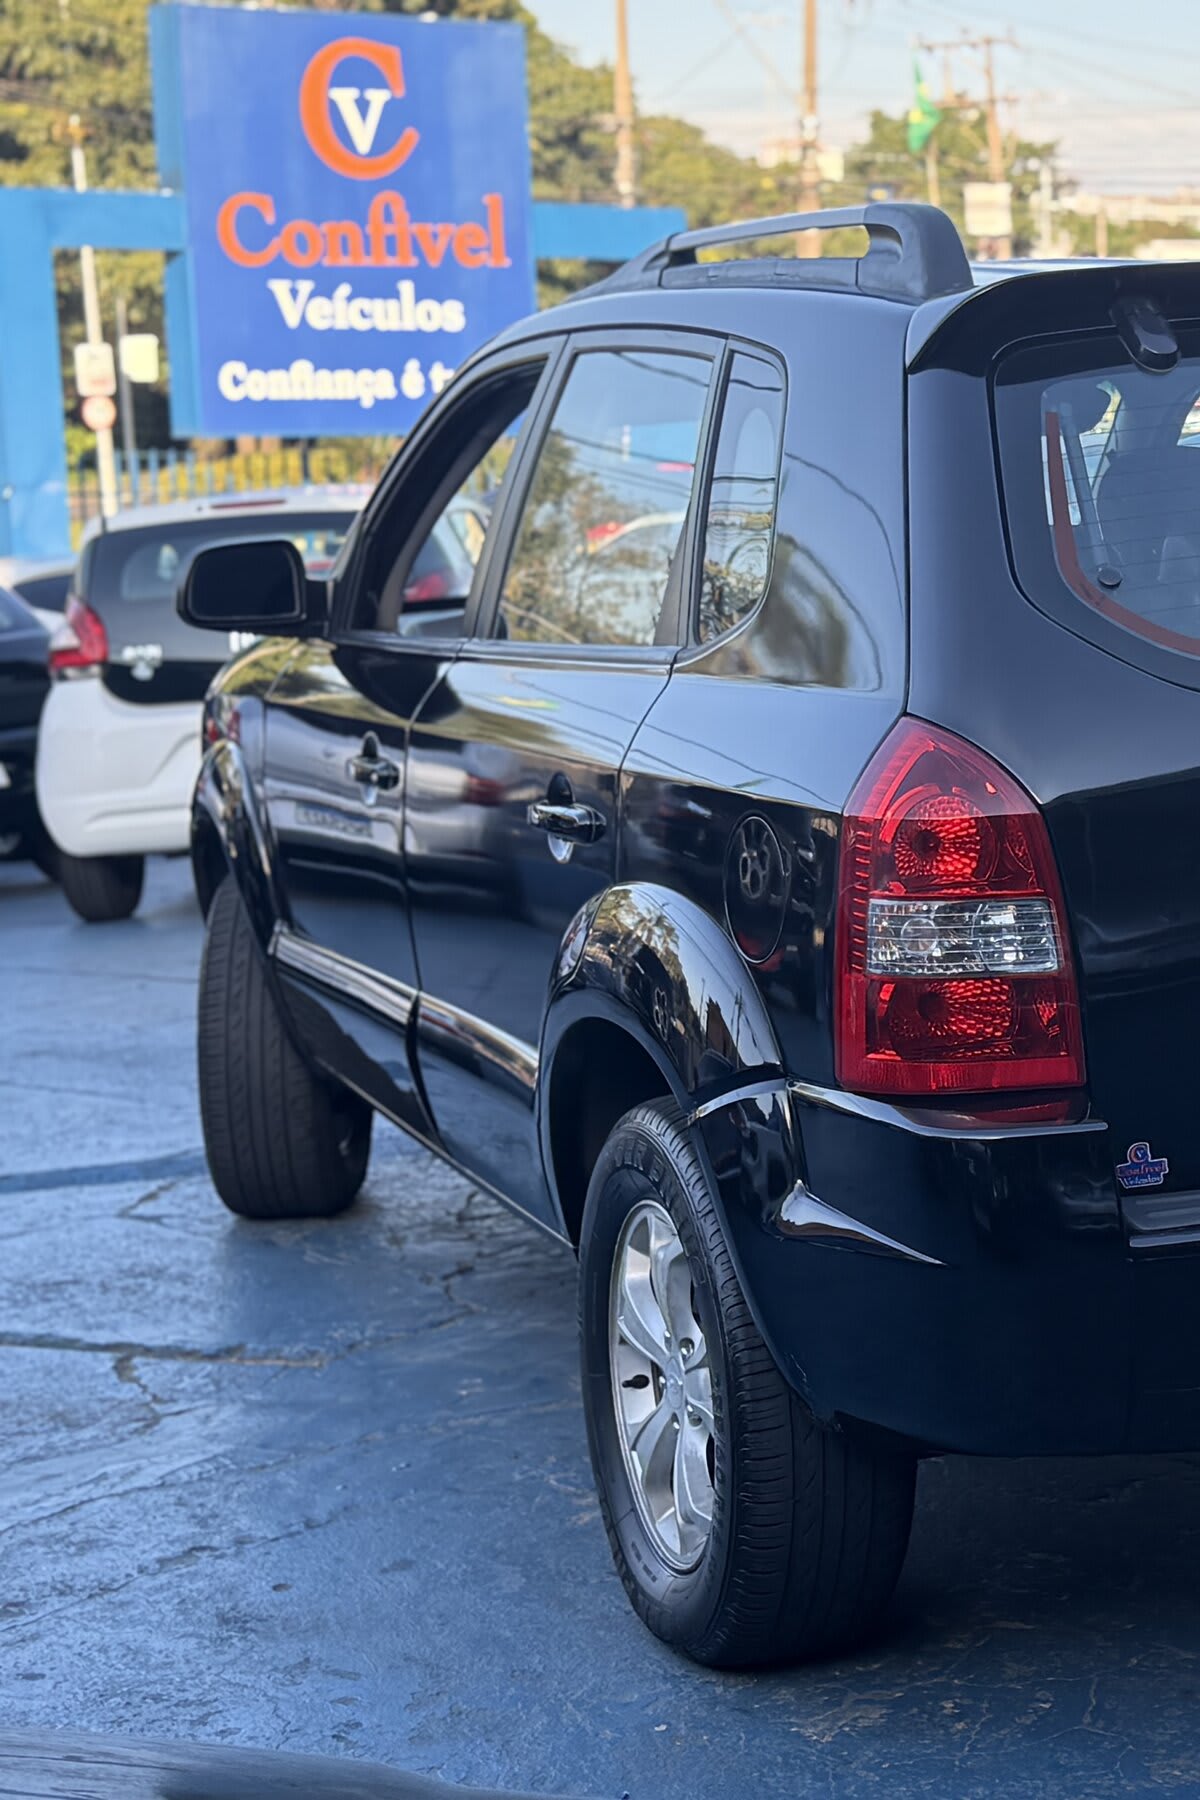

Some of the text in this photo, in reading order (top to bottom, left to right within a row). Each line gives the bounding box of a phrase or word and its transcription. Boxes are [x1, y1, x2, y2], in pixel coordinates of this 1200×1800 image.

[267, 278, 467, 334] Veículos
[217, 358, 398, 409] Confiança
[401, 358, 425, 400] é
